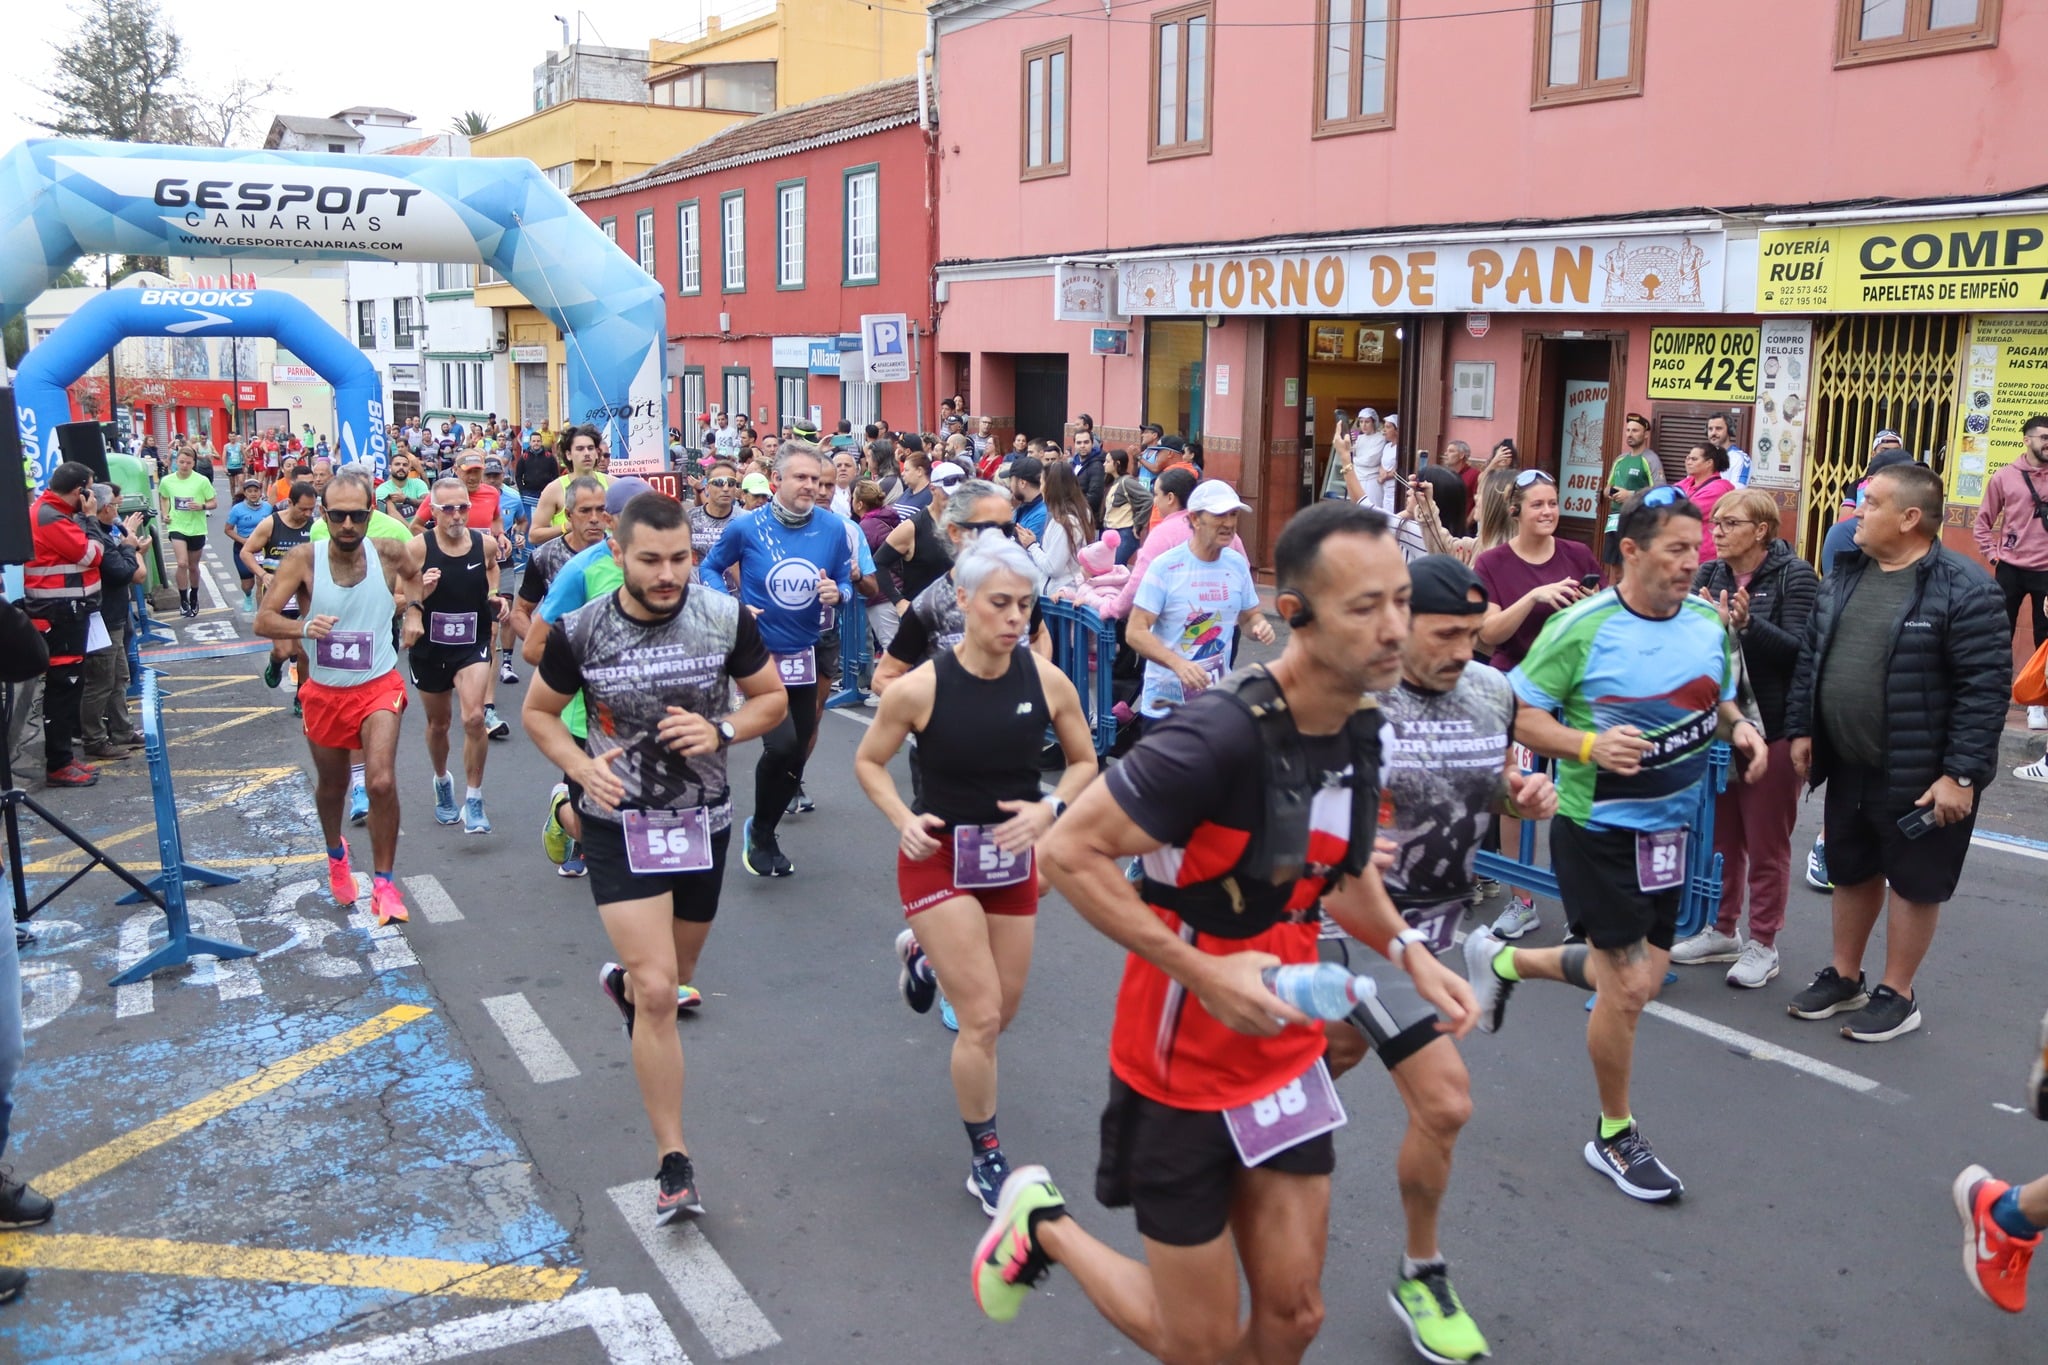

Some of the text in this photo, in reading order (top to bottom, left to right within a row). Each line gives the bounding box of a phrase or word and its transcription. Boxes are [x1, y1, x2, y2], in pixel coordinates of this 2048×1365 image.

[154, 178, 421, 217] GESPORT
[185, 212, 381, 231] CANARIAS
[179, 234, 403, 250] WWW.GESPORTCANARIAS.COM
[1764, 238, 1830, 257] JOYERÍA
[1189, 245, 1594, 309] HORNO DE PAN
[1770, 257, 1824, 282] RUBÍ
[140, 290, 255, 307] BROOKS
[1780, 286, 1828, 295] 922 573 452
[1863, 284, 1935, 301] PAPELETAS
[1938, 283, 1956, 299] DE
[1960, 278, 2019, 299] EMPEÑO
[1779, 296, 1827, 305] 627 195 104
[1977, 319, 2013, 327] TENEMOS
[1654, 332, 1754, 356] COMPRO ORO
[1767, 336, 1804, 344] COMPRO
[811, 348, 840, 367] Allianz
[1765, 346, 1804, 355] RELOJES
[1651, 377, 1691, 390] HASTA
[1652, 357, 1756, 392] PAGO 42€
[1569, 387, 1608, 407] HORNO
[1990, 440, 2024, 448] COMPRO
[1564, 497, 1592, 512] 6:30
[443, 623, 466, 637] 83
[330, 642, 361, 661] 84
[780, 658, 805, 676] 65
[647, 827, 690, 855] 56
[1652, 844, 1677, 873] 52
[909, 888, 954, 911] LURBEL
